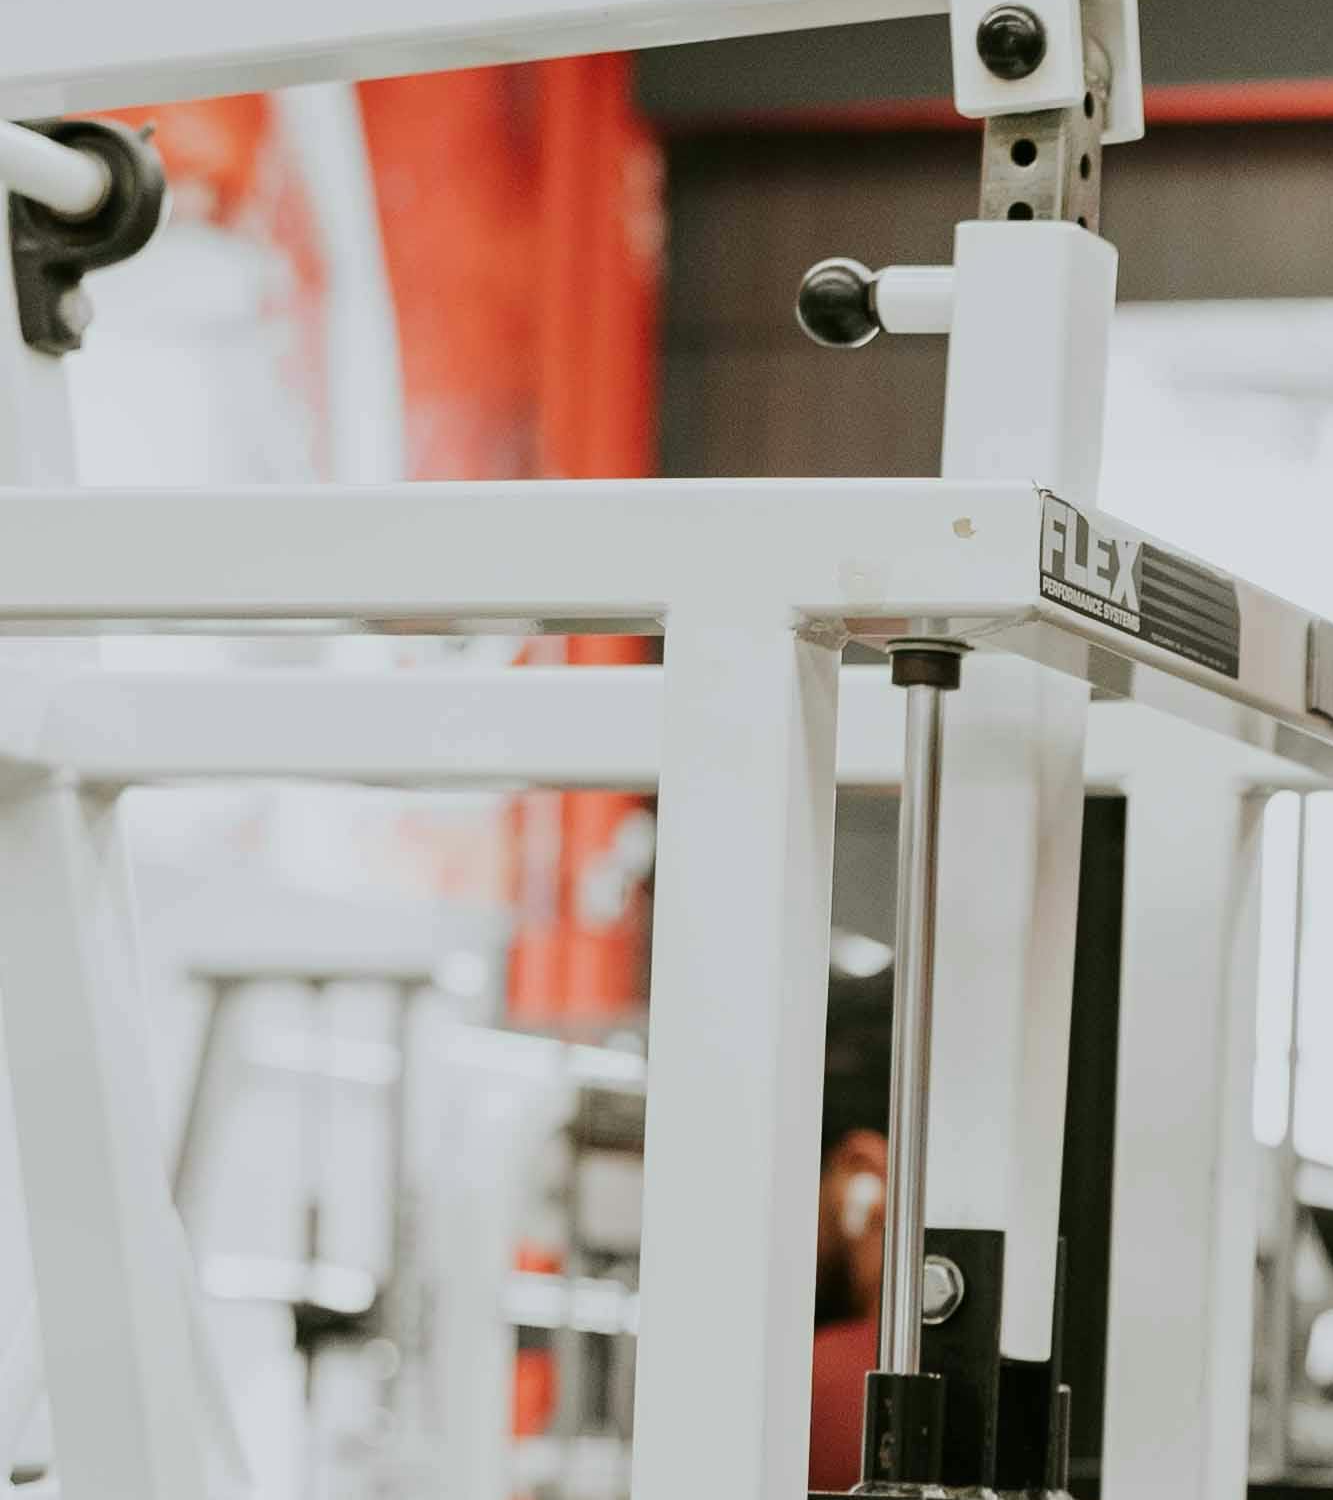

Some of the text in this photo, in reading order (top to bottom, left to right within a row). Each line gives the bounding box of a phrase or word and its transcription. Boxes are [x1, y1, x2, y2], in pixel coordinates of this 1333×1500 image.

[1042, 495, 1141, 613] FLEX
[1042, 575, 1141, 634] PERFORMANCE SYSTEMS
